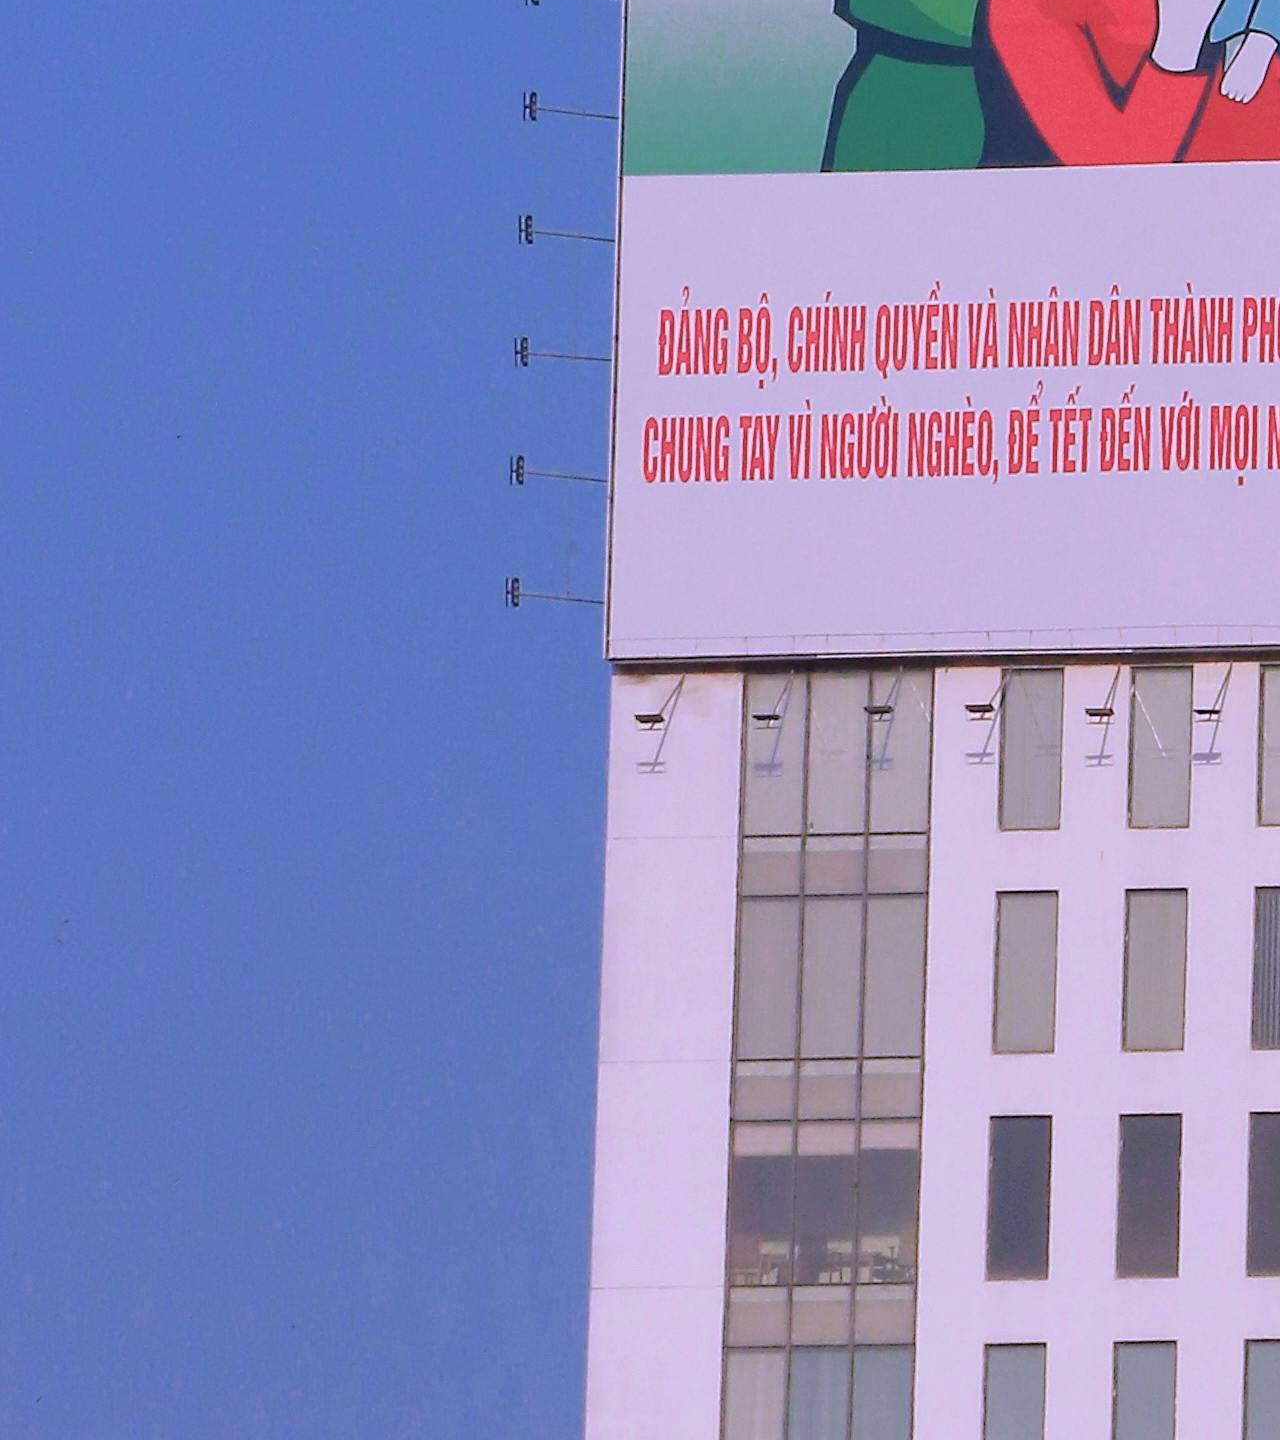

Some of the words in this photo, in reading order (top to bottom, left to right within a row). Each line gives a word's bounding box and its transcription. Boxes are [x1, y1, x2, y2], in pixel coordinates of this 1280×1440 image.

[657, 285, 729, 375] ĐẢNG
[737, 292, 777, 389] BỘ,
[787, 291, 866, 373] CHÍNH
[875, 281, 959, 379] QUYỀN
[968, 287, 998, 369] VÀ
[1008, 286, 1080, 367] NHÂN
[1088, 284, 1141, 365] DÂN
[1150, 282, 1233, 364] THÀNH
[642, 415, 730, 482] CHUNG
[739, 414, 780, 481] TAY
[789, 398, 812, 479] VÌ
[820, 395, 899, 479] NGƯỜI
[907, 395, 999, 484] NGHÈO,
[1008, 380, 1043, 474] ĐỂ
[1049, 385, 1093, 473] TẾT
[1100, 384, 1151, 471] ĐẾN
[1160, 391, 1200, 471] VỚI
[1209, 404, 1258, 486] MỌI
